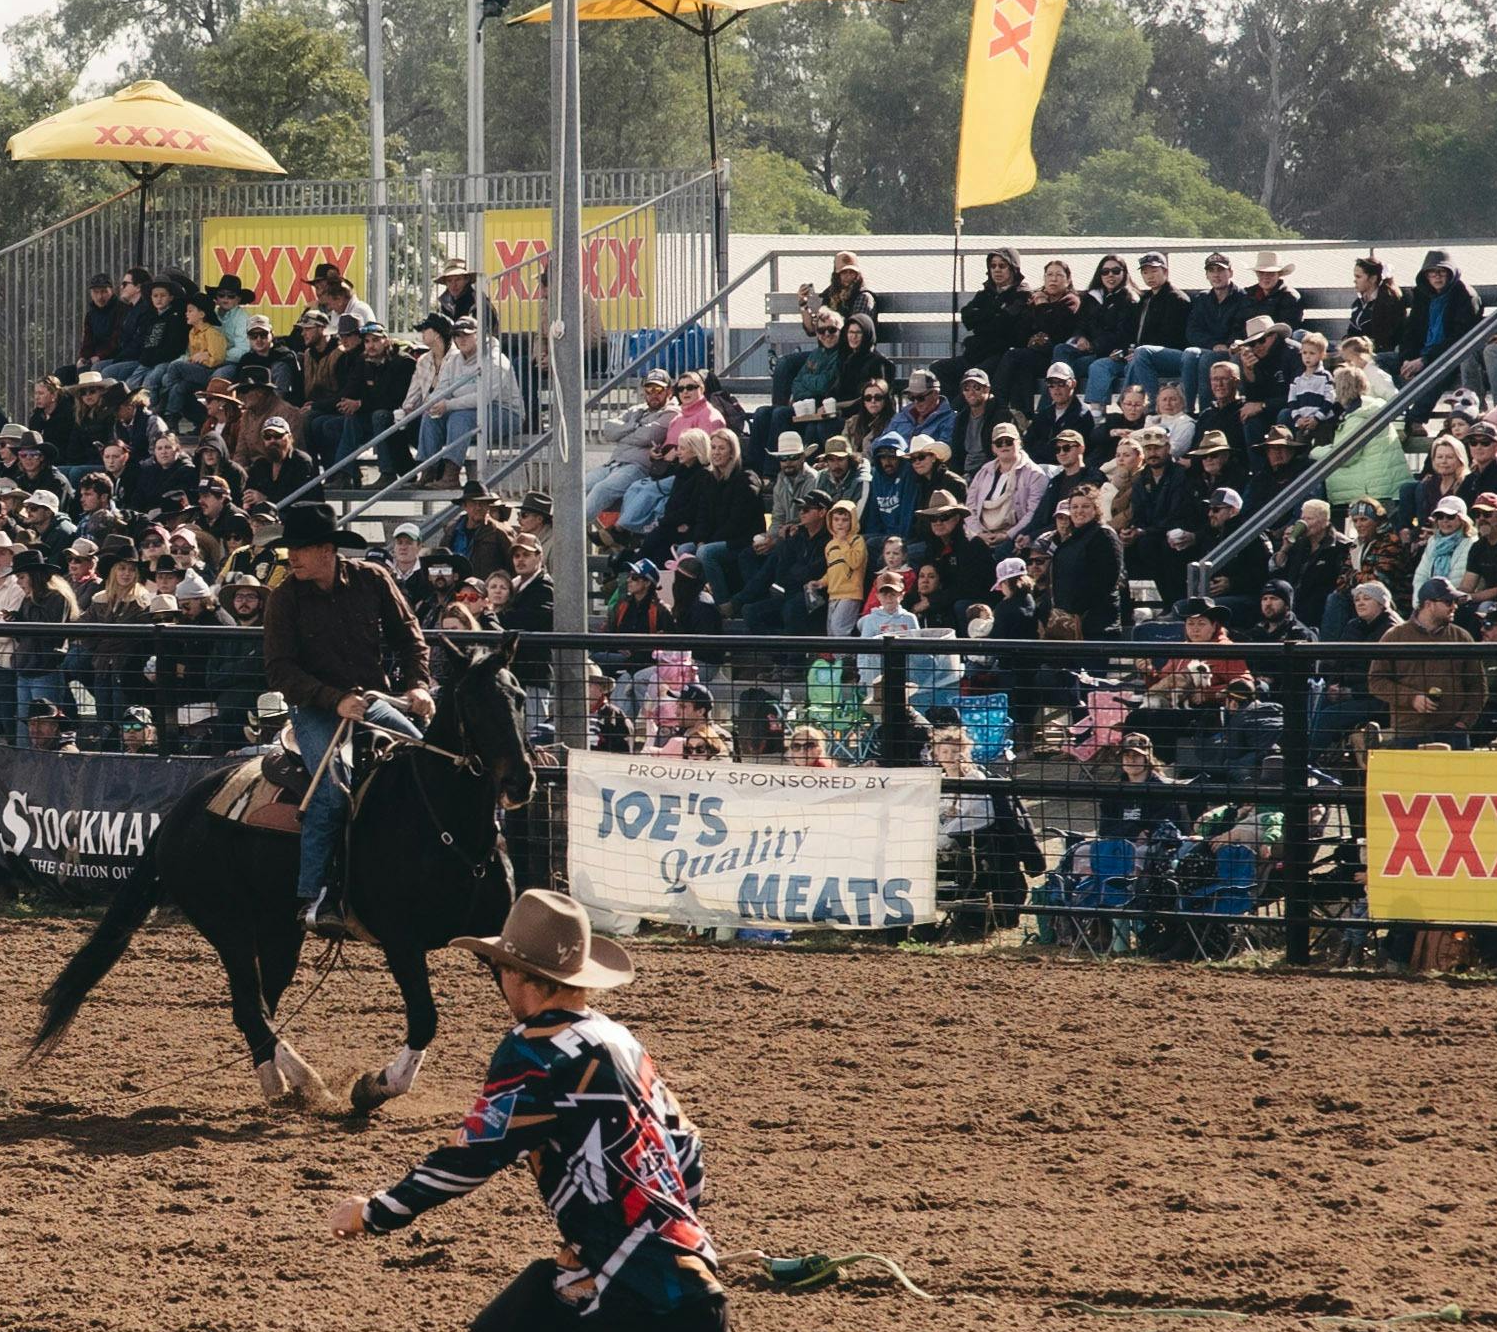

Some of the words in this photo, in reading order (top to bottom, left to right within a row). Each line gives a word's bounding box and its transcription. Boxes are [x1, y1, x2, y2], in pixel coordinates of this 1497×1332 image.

[95, 125, 211, 153] XXXX
[628, 763, 717, 783] PROUDLY
[728, 770, 857, 790] SPONSORED
[866, 776, 890, 790] BY
[598, 787, 728, 847] JOE'S
[29, 859, 56, 875] THE
[58, 861, 108, 879] STATION
[660, 825, 812, 894] Quality
[737, 873, 915, 926] MEATS
